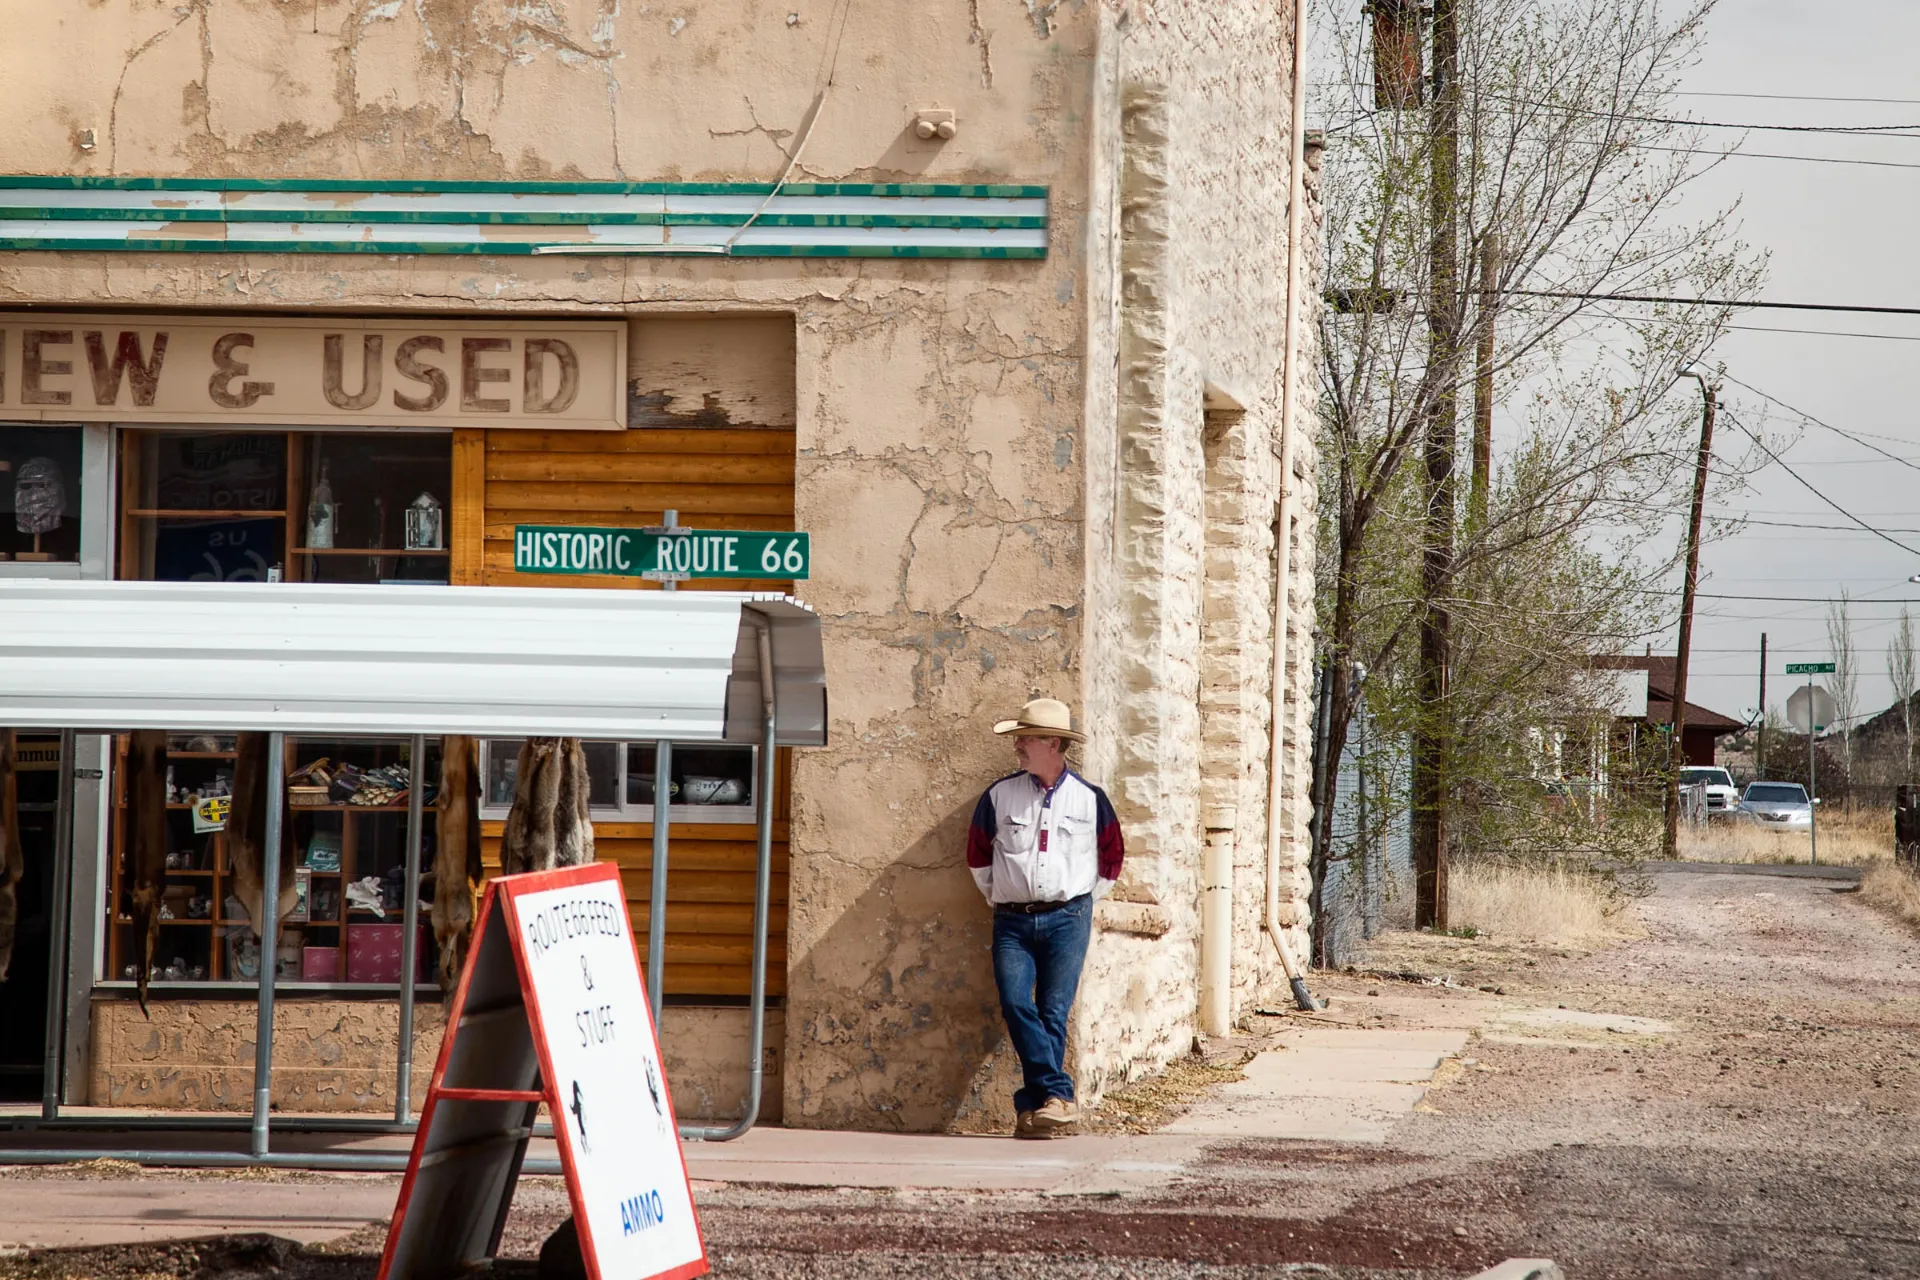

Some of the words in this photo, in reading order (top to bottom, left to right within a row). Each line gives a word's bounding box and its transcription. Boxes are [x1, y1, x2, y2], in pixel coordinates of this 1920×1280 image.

[0, 329, 169, 407] EW
[208, 332, 275, 410] &
[322, 333, 581, 414] USED
[516, 531, 631, 571] HISTORIC
[656, 536, 739, 572] ROUTE
[761, 537, 803, 574] 66
[1787, 664, 1819, 673] PICACHO
[580, 955, 595, 991] &
[575, 1005, 615, 1048] STUFF
[620, 1188, 665, 1237] AMMO
